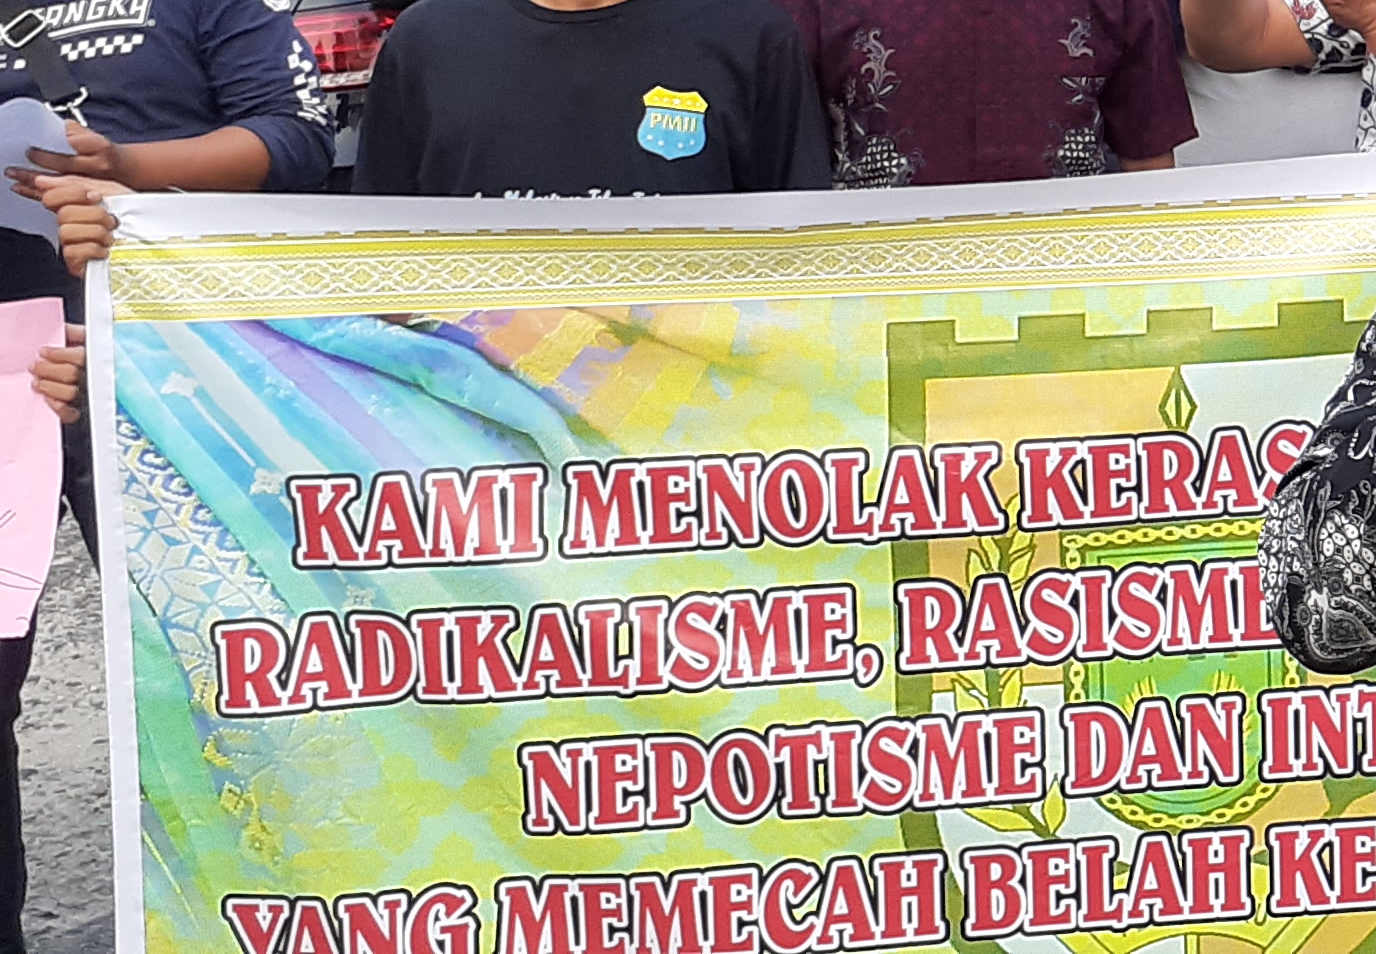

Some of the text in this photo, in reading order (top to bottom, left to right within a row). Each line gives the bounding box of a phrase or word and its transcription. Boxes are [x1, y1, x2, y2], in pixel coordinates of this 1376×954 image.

[649, 110, 698, 133] PMII
[290, 424, 1315, 568] KAMI MENOLAK KERAS
[213, 583, 882, 714] RADIKALISME,
[520, 710, 1045, 833] NEPOTISME
[1064, 693, 1251, 796] DAN
[223, 882, 479, 954] YANG
[496, 849, 950, 954] MEMECAH
[963, 826, 1251, 937] BELAH
